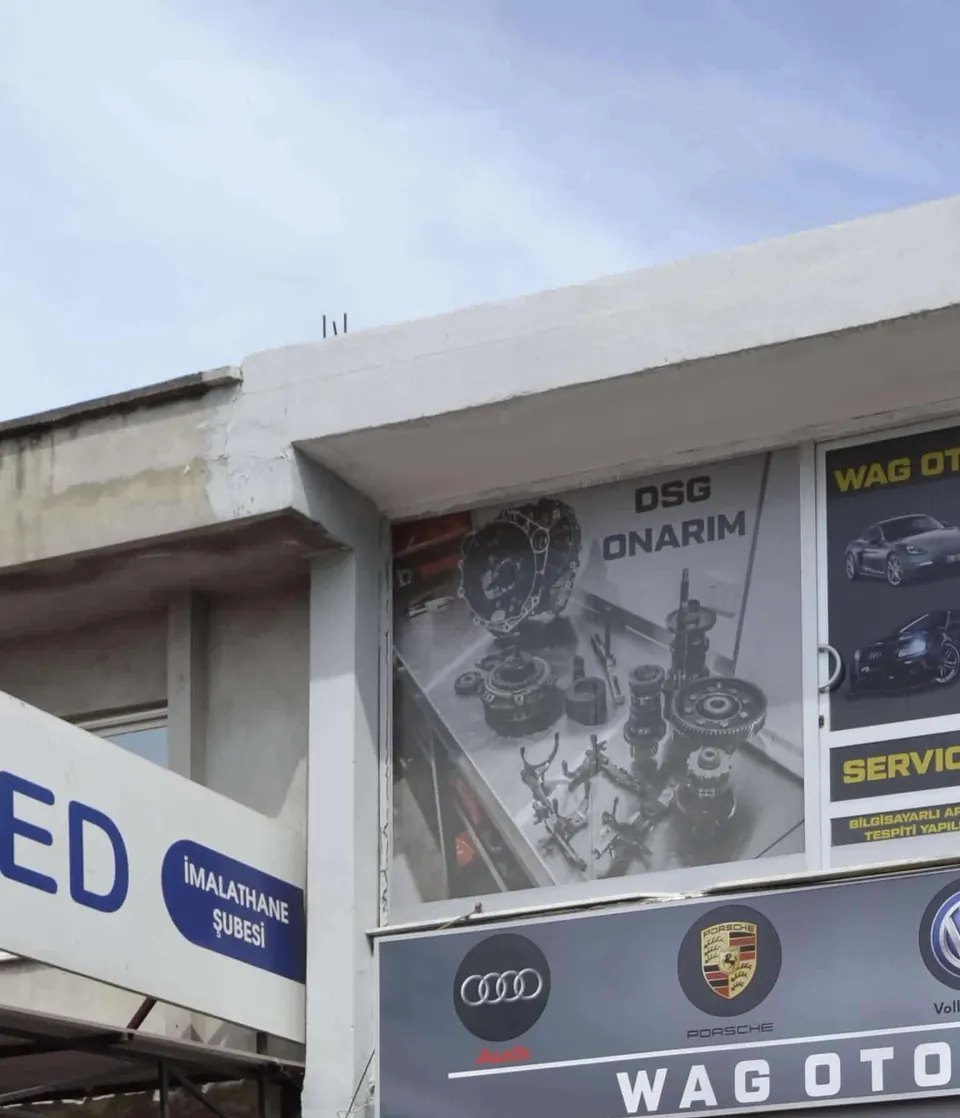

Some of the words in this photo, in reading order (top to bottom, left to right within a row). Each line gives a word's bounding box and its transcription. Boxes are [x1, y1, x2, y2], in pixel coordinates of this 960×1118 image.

[833, 458, 912, 492] WAG
[634, 476, 712, 514] DSG
[602, 511, 746, 562] ONARIM
[849, 809, 940, 830] BİLGİSAYARLI
[864, 825, 916, 841] TESPİTİ
[0, 770, 129, 914] ED
[183, 855, 289, 925] İMALATHANE
[212, 908, 265, 948] ŞUBESİ
[703, 923, 756, 939] PORSCHE
[686, 1022, 775, 1039] PORSCHE
[475, 1044, 530, 1067] Audi
[616, 1059, 772, 1115] WAG
[804, 1041, 952, 1098] OTO
